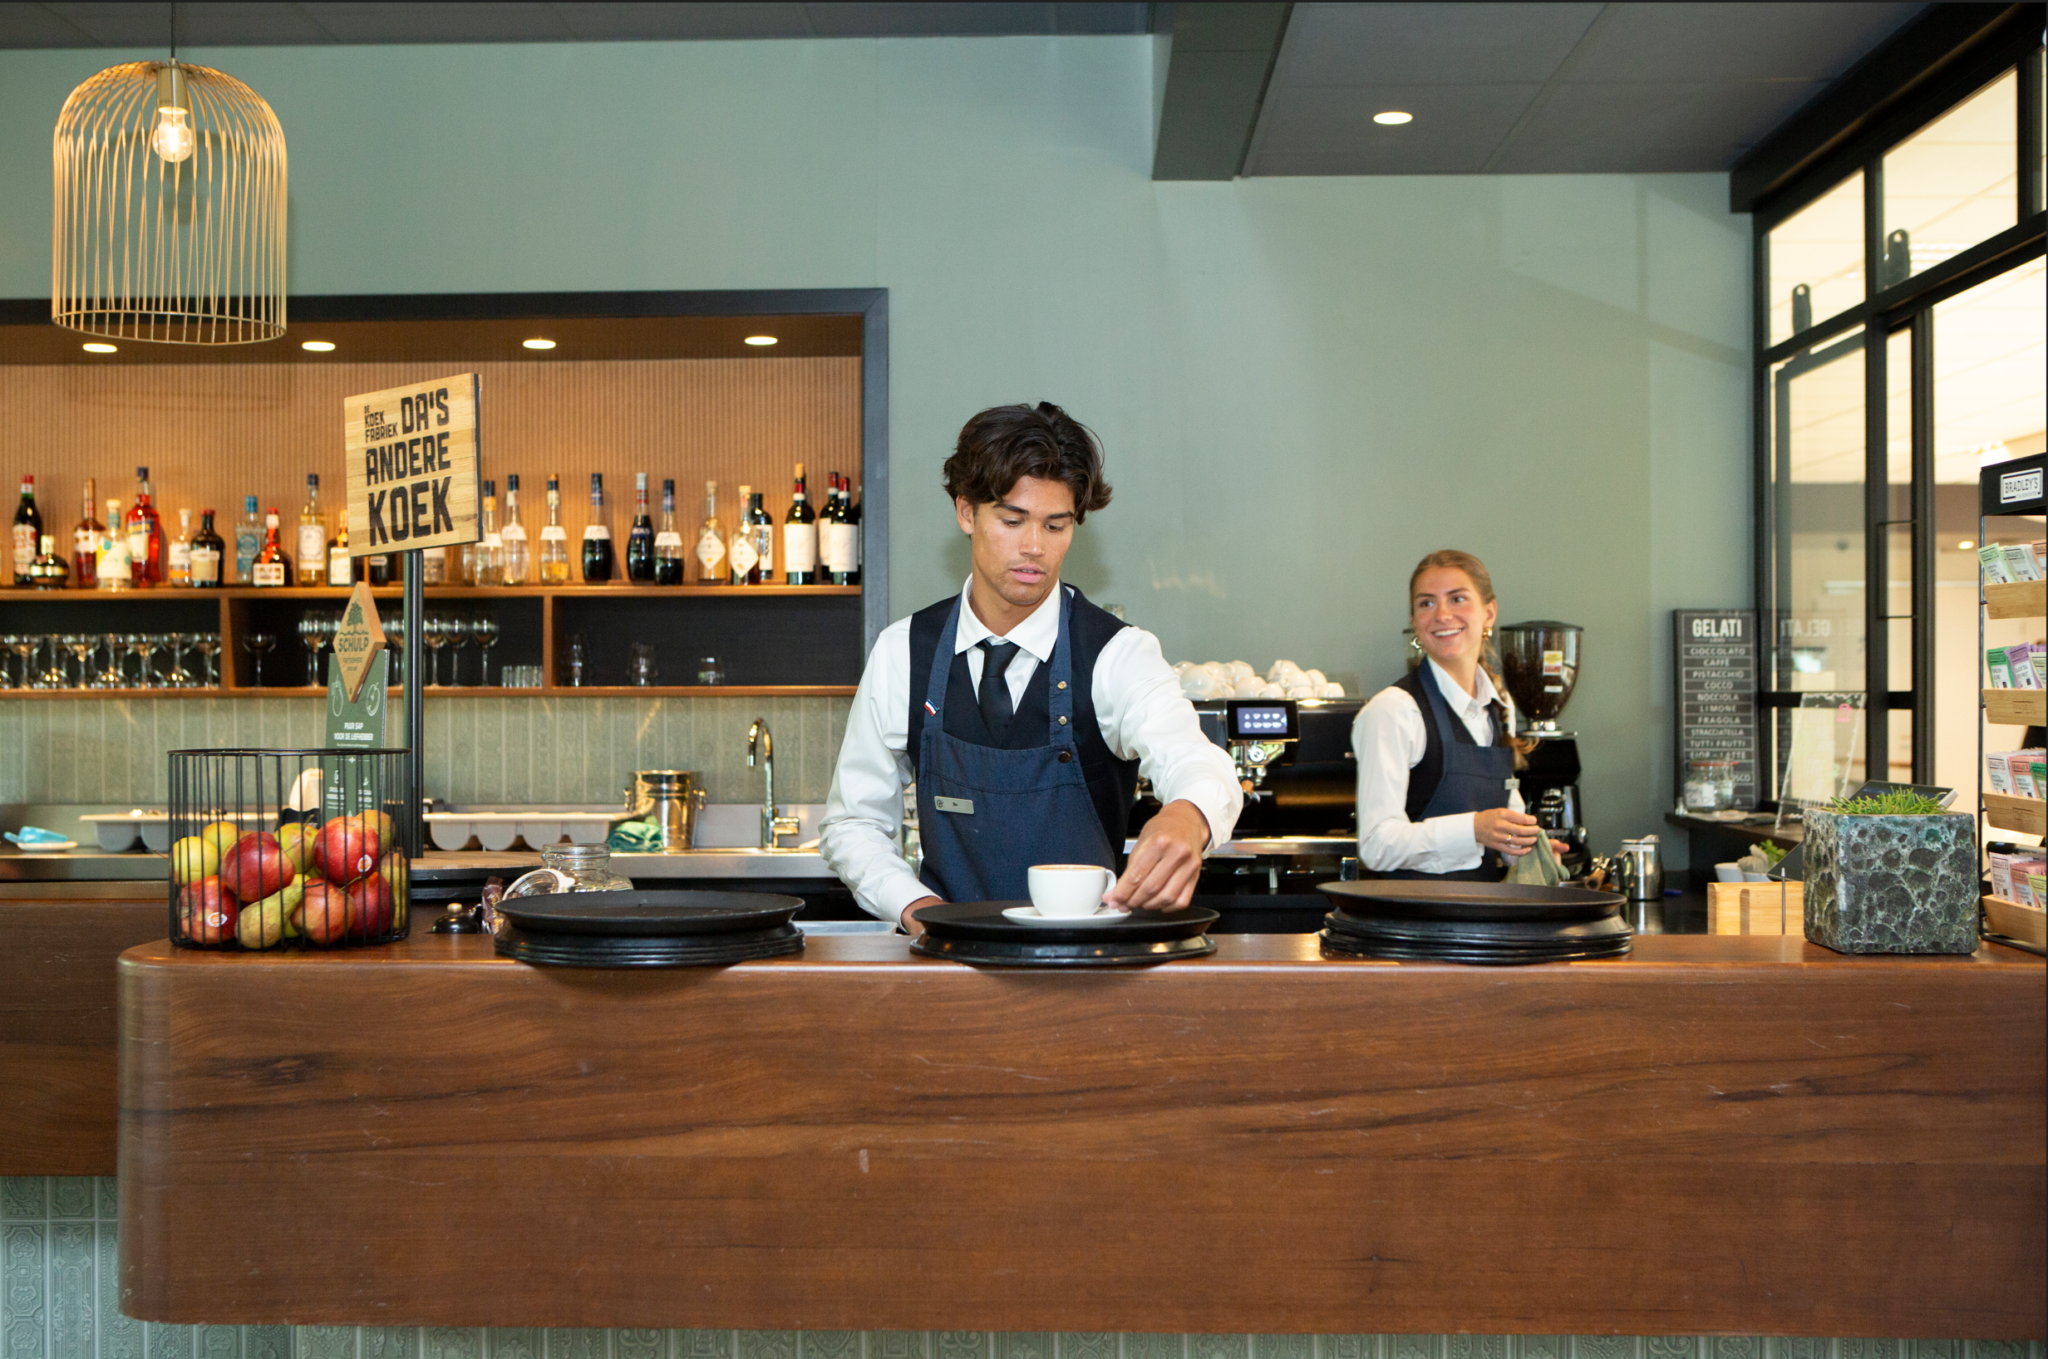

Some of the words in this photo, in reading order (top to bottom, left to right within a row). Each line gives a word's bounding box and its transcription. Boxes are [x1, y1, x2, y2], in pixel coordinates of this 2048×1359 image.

[364, 405, 370, 414] DE
[400, 387, 450, 435] DA'S
[364, 410, 386, 428] KOEK
[365, 422, 398, 443] FABRIEK
[365, 431, 452, 486] ANDERE
[2005, 477, 2038, 493] BRADLEY'S
[368, 476, 454, 547] KOEK
[1692, 618, 1742, 637] GELATI
[338, 636, 369, 652] SCHULP
[1690, 647, 1746, 656] CIOCCOLATO
[1693, 670, 1745, 679] PISTACCHIO
[1704, 680, 1734, 690] COCCO
[1697, 693, 1740, 701] NOCCIOLA
[1700, 704, 1737, 713] LIMONE
[1698, 716, 1741, 724] FRAGOLA
[1690, 740, 1714, 748] TUTTI
[1715, 740, 1746, 748] FRUTTI
